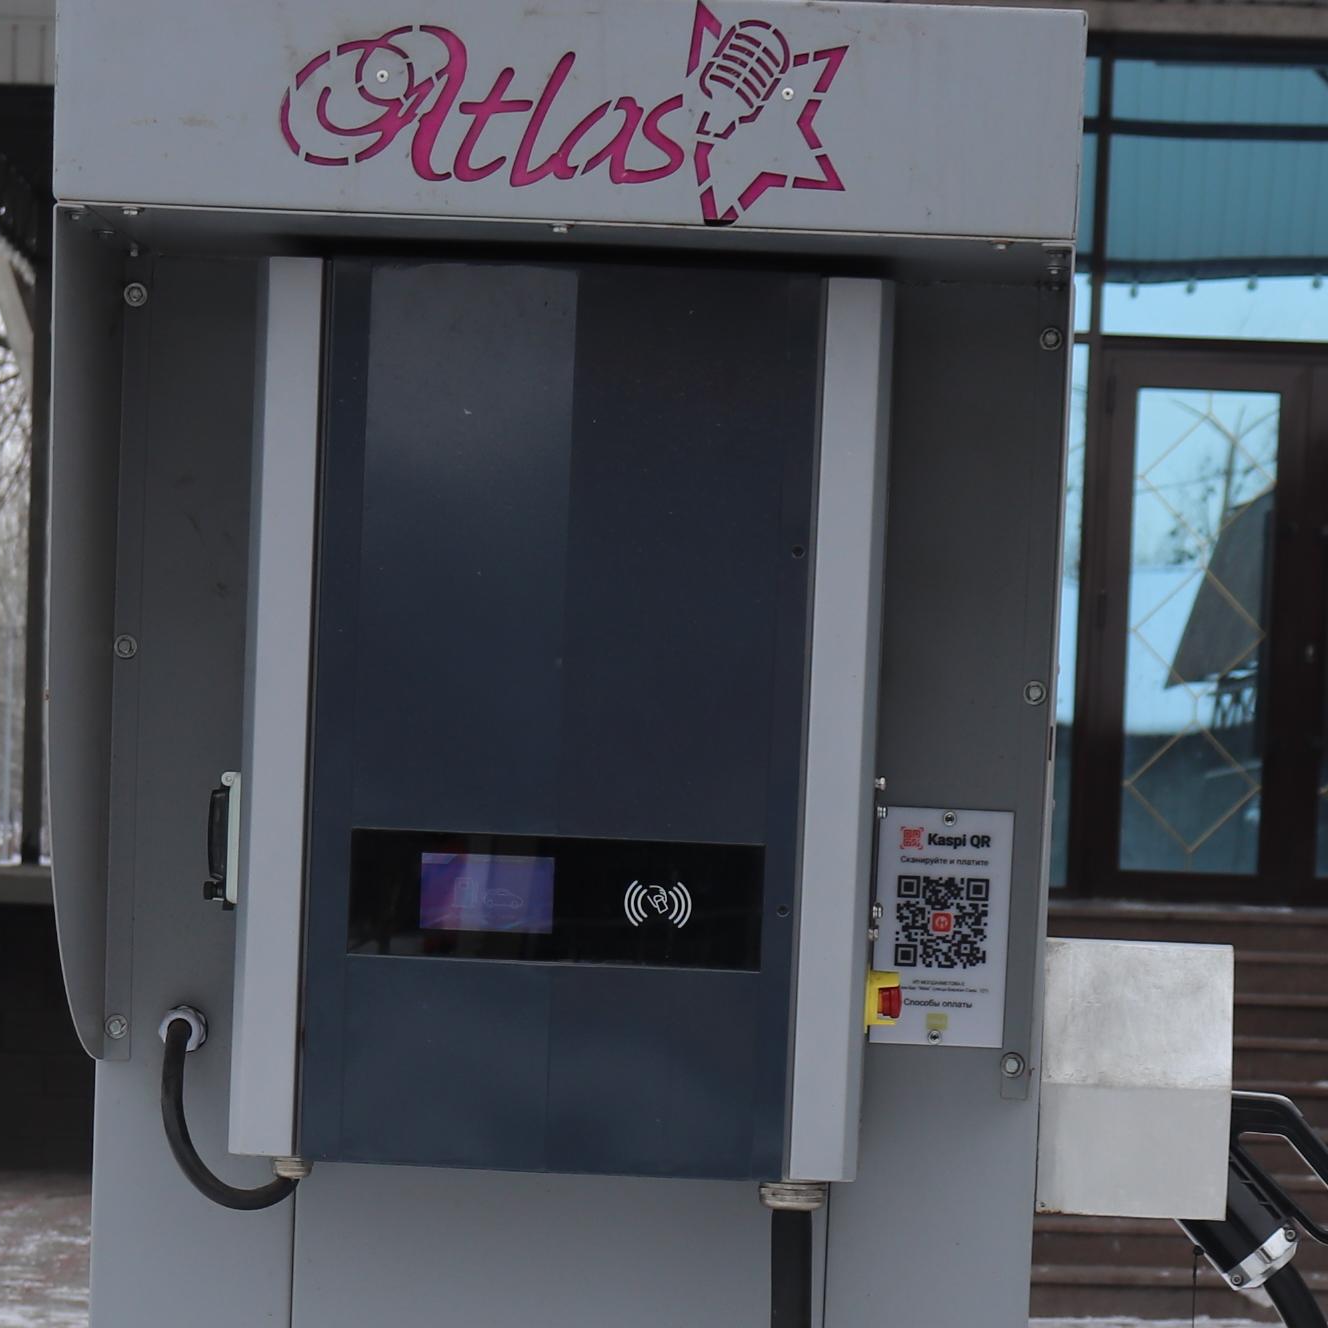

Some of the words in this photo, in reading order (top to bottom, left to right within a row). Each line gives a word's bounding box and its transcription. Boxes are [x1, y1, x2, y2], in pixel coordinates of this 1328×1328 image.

[279, 24, 685, 188] Atlas
[928, 833, 966, 849] Kaspi
[970, 835, 991, 848] QR
[900, 856, 947, 865] Сканируйте
[904, 998, 940, 1008] Способы
[942, 1001, 973, 1010] оплаты
